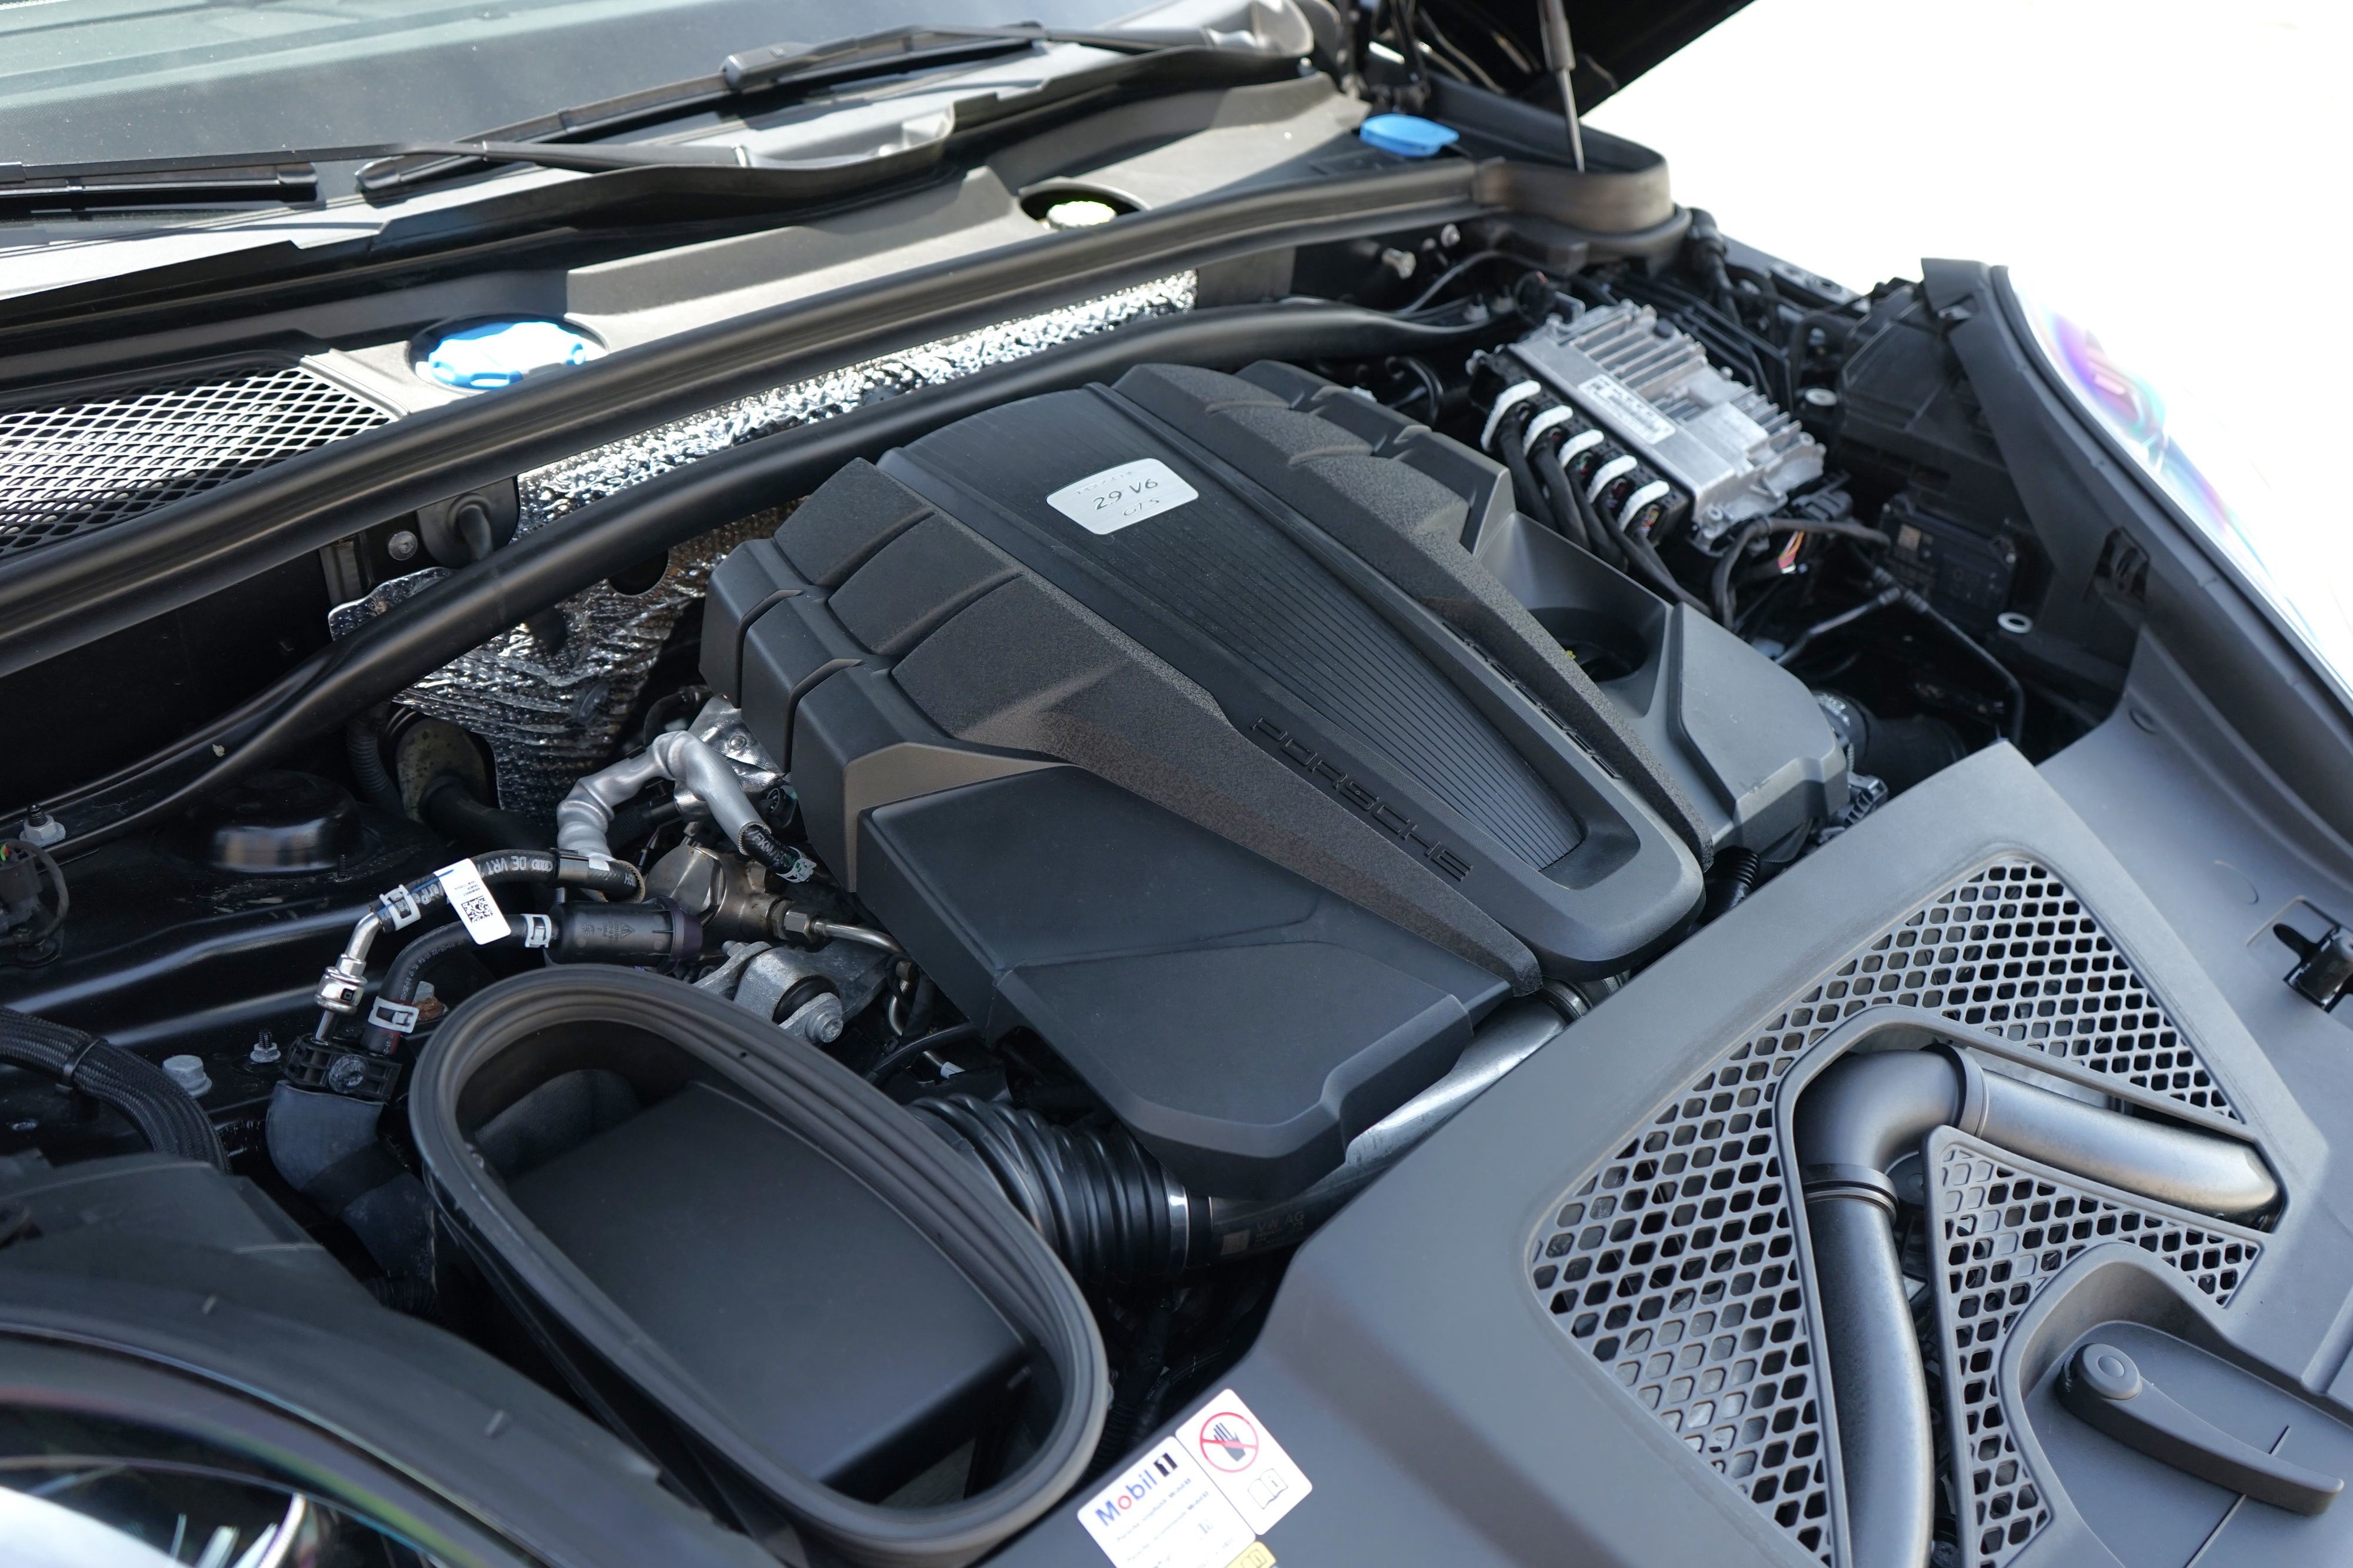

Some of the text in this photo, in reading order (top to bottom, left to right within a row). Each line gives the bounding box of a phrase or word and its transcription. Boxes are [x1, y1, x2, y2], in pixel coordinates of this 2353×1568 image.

[1129, 478, 1158, 493] V6
[1249, 714, 1475, 882] PORSCHE
[484, 858, 507, 875] VRT
[511, 856, 526, 871] DE
[1286, 1210, 1305, 1224] AG
[1095, 1470, 1158, 1526] Mobil
